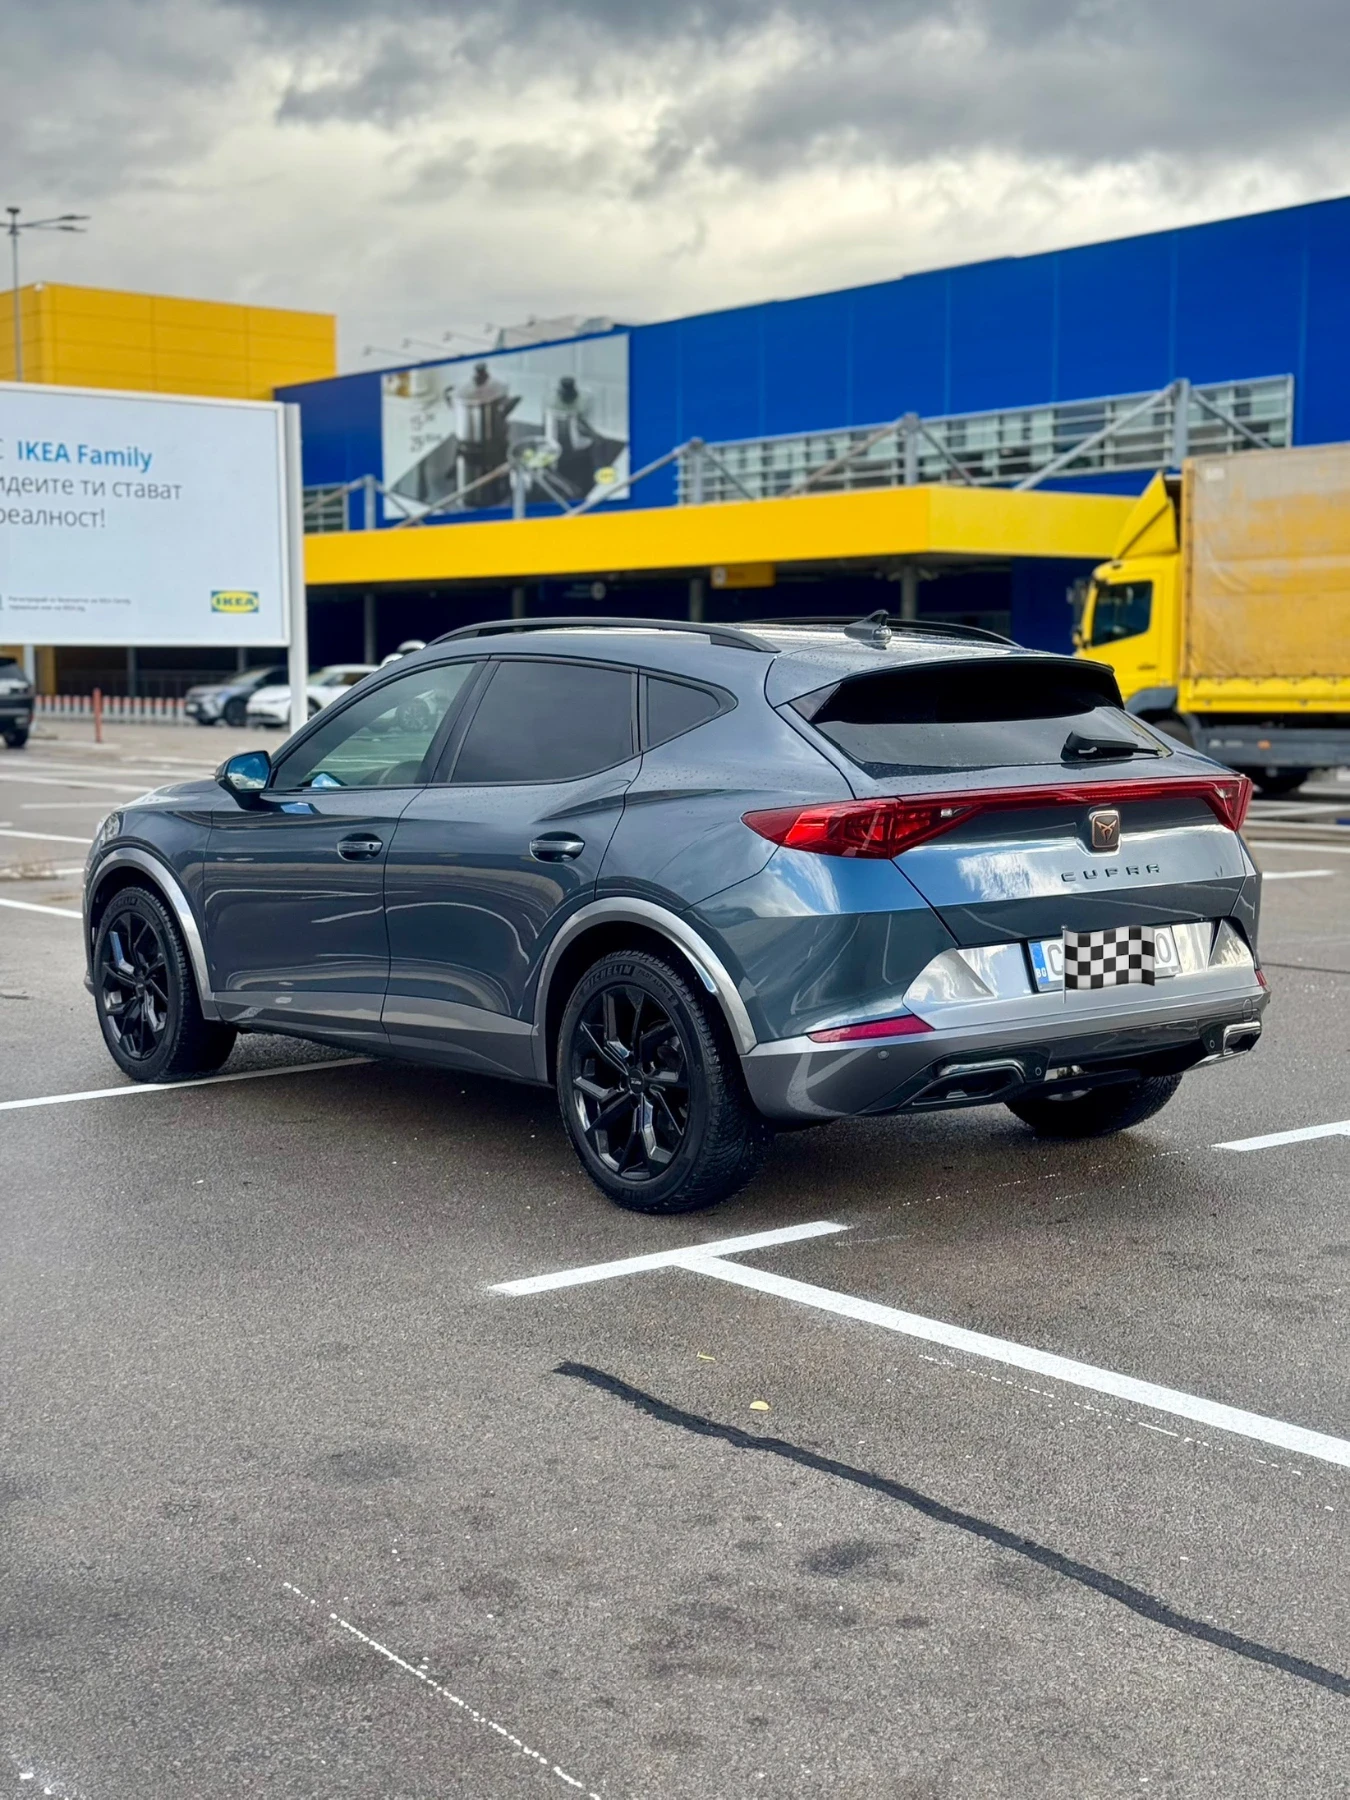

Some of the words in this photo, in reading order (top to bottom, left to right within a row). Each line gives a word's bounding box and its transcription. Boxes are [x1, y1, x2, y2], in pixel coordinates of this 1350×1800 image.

[17, 441, 70, 463] IKEA
[77, 444, 152, 473] Family
[80, 480, 106, 496] ти
[112, 481, 182, 500] стават
[216, 597, 254, 606] IKEA
[1061, 864, 1160, 882] CUPRA
[1035, 967, 1048, 978] BG
